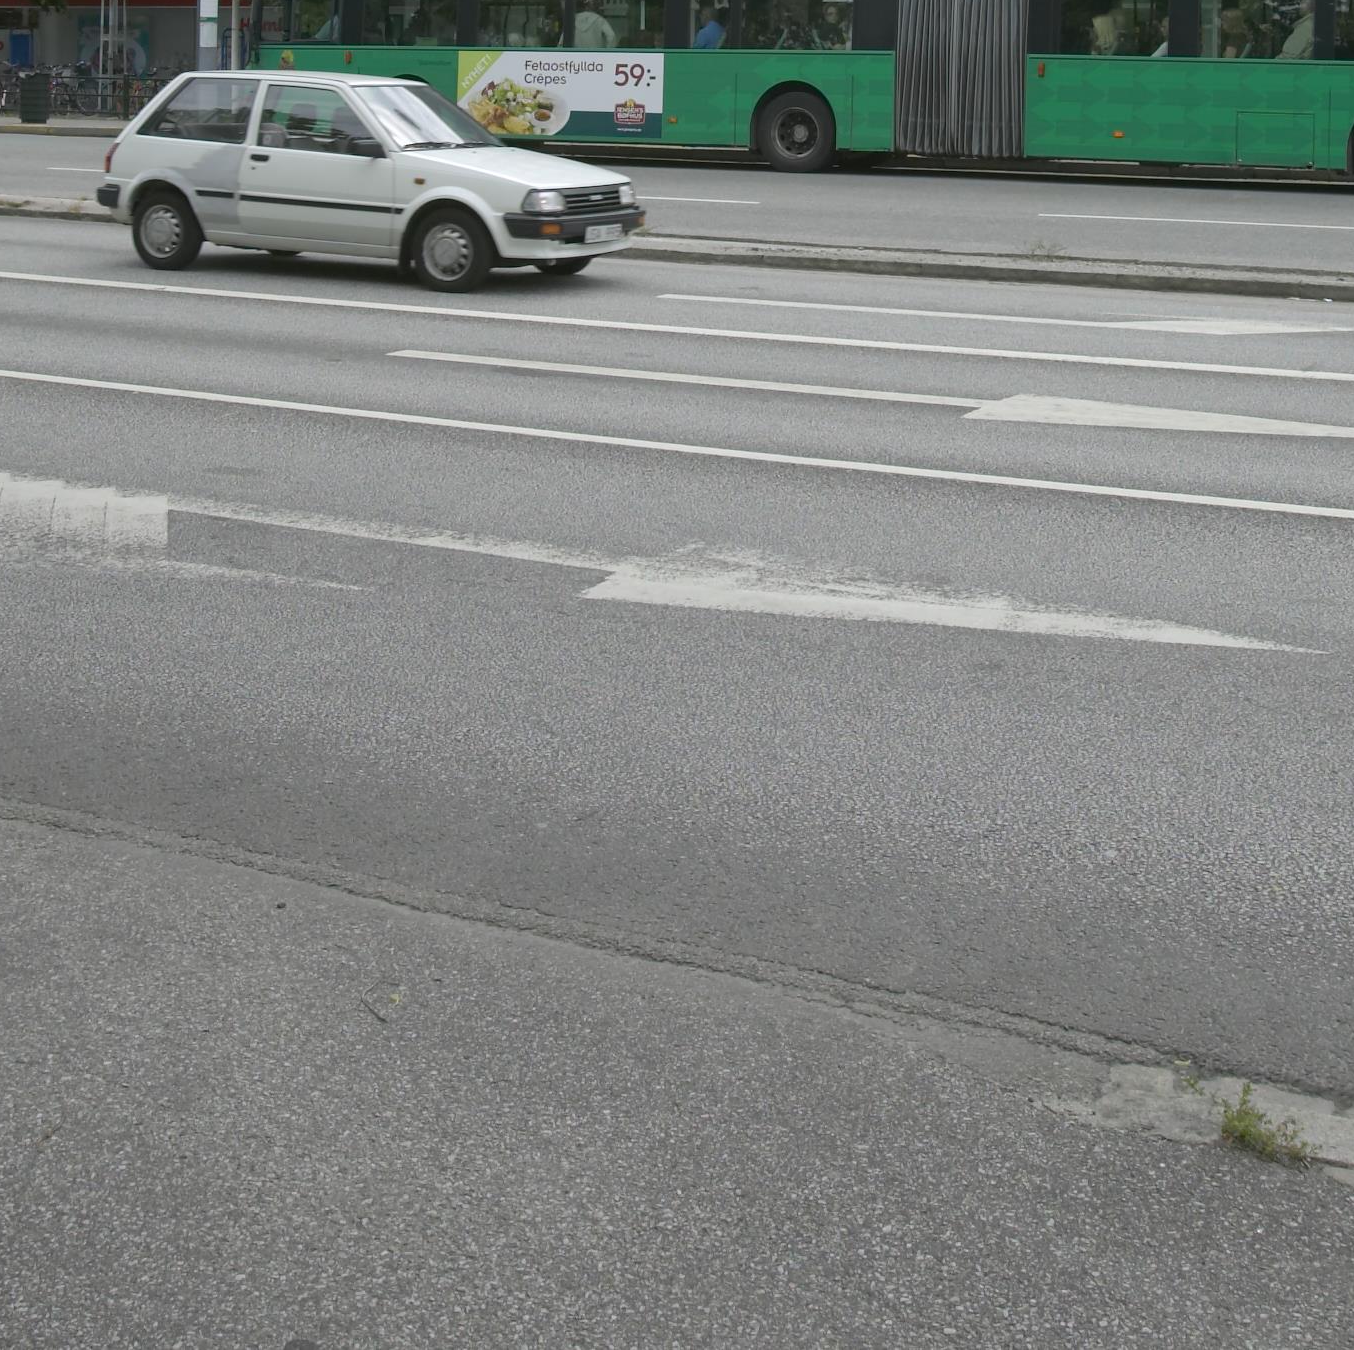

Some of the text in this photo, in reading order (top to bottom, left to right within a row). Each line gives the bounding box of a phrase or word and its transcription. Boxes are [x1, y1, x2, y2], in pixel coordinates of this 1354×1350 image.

[461, 53, 493, 89] NYHET!
[525, 60, 604, 75] Fetaostfyllda
[614, 63, 657, 87] 59:-
[525, 73, 567, 86] Crêpes
